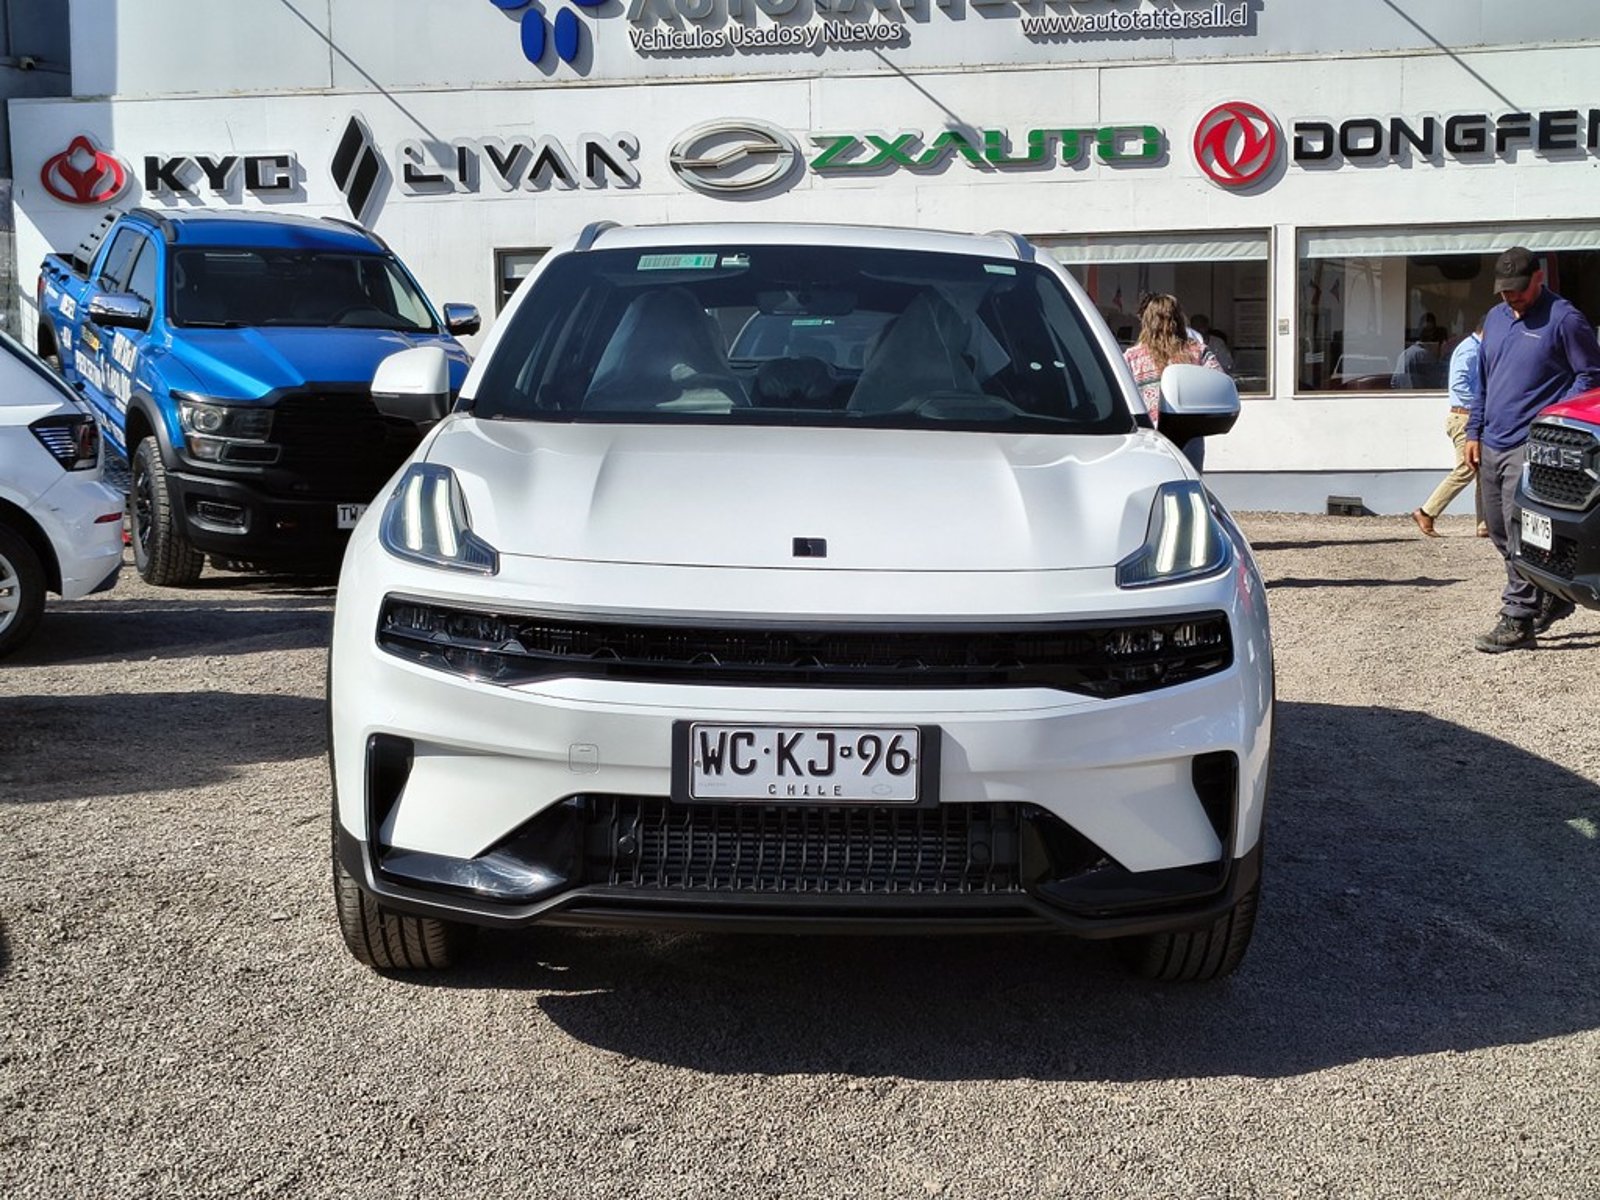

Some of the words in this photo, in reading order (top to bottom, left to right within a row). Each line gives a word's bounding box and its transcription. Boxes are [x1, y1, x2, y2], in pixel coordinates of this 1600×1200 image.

[1020, 3, 1248, 33] www.autotattersall.cl
[628, 27, 724, 49] Vehículos
[729, 23, 802, 47] Usados
[806, 26, 819, 46] y
[824, 22, 900, 42] Nuevos
[403, 139, 627, 183] LIVAN
[809, 125, 1162, 169] ZXAUTO
[767, 783, 842, 796] CHILE
